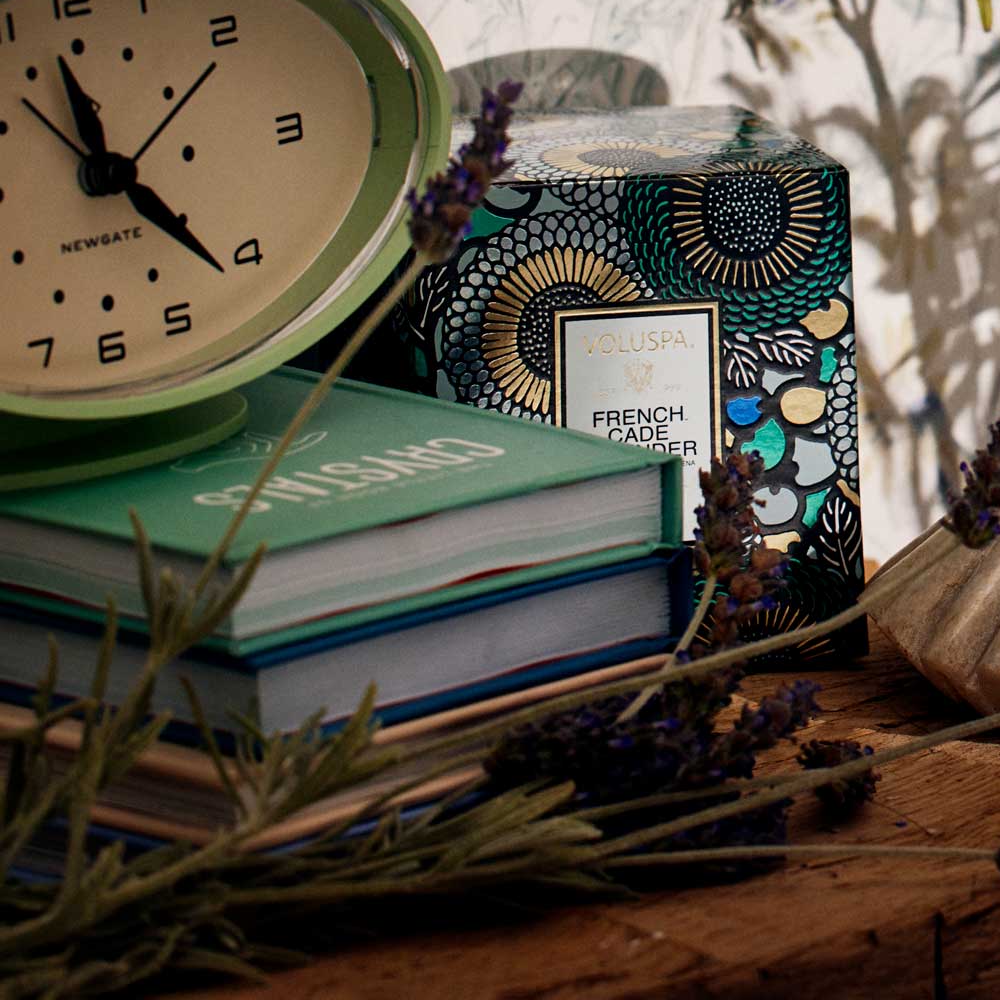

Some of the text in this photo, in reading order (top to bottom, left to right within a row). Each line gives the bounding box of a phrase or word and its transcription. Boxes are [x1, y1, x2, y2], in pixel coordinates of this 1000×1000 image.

[0, 11, 16, 44] 1
[209, 14, 239, 48] 2
[274, 111, 304, 146] 3
[60, 226, 143, 255] NEWGATE
[233, 237, 264, 266] 4
[163, 301, 193, 337] 5
[27, 336, 55, 369] 7
[98, 330, 127, 364] 6
[593, 405, 684, 428] FRENCH
[608, 424, 669, 443] CADE
